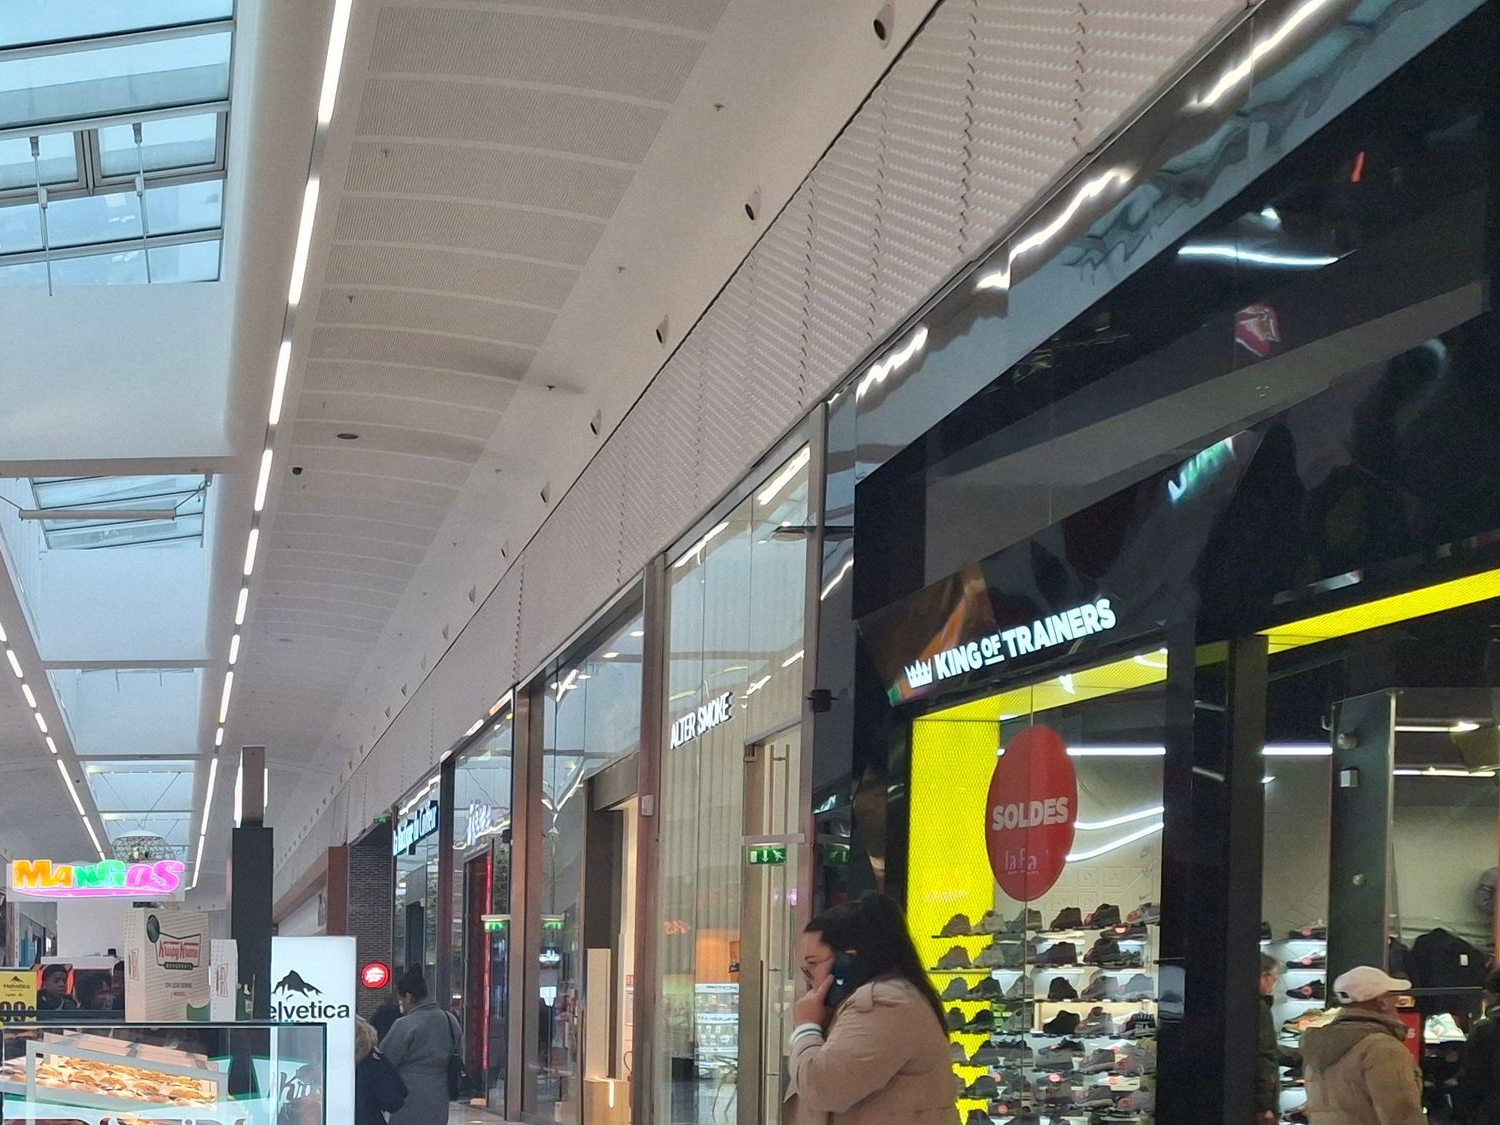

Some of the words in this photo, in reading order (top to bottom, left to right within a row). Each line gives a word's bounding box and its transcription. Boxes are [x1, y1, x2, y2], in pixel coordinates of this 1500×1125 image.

[934, 641, 983, 680] KING
[982, 633, 1005, 659] OF
[1002, 598, 1117, 658] TRAINERS
[670, 711, 696, 750] ALTER
[697, 691, 732, 734] SMOKE
[992, 797, 1069, 831] SOLDES
[269, 1000, 350, 1021] elvetica
